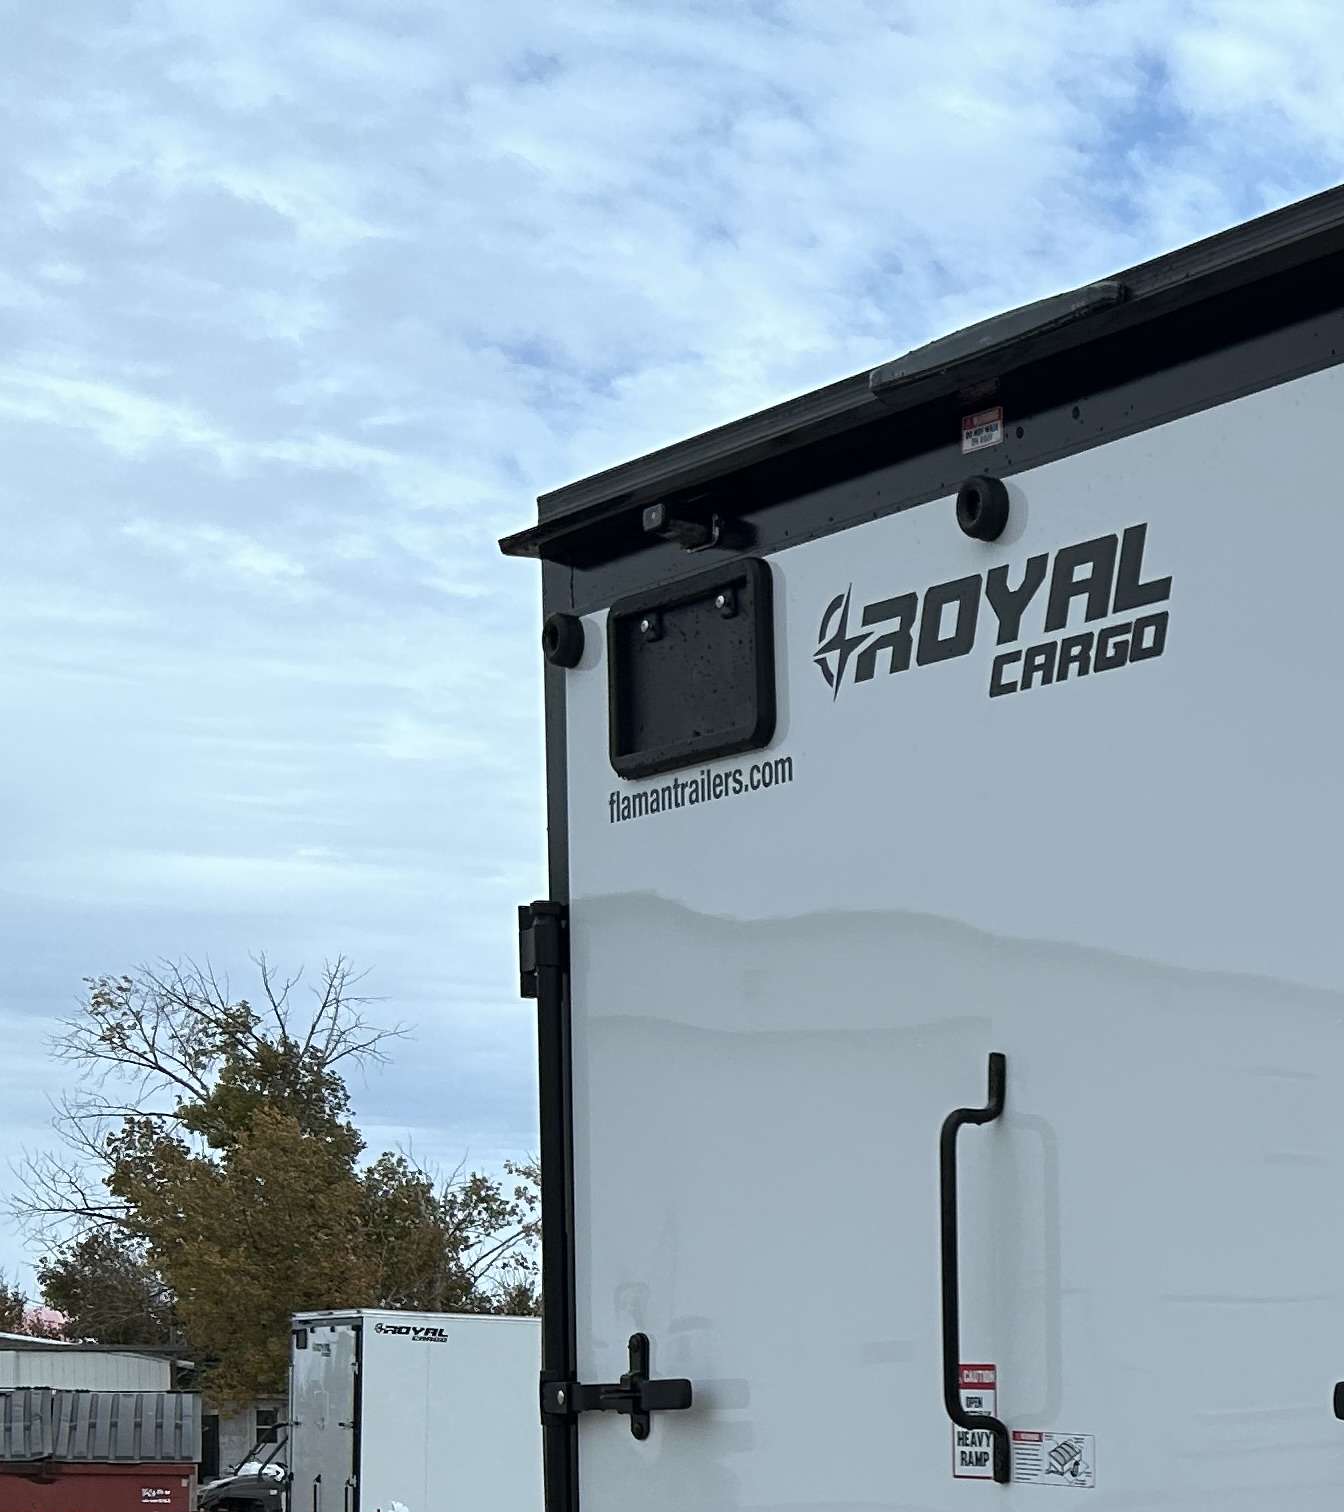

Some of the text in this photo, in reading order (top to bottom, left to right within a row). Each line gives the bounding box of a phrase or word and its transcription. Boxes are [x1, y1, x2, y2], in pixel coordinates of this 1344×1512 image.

[855, 523, 1173, 683] ROYAL
[989, 611, 1170, 698] CARGO
[609, 754, 794, 824] flamantrailers.com
[383, 1325, 449, 1338] ROYAL
[957, 1431, 992, 1448] HEAVY
[960, 1450, 990, 1467] RAMP
